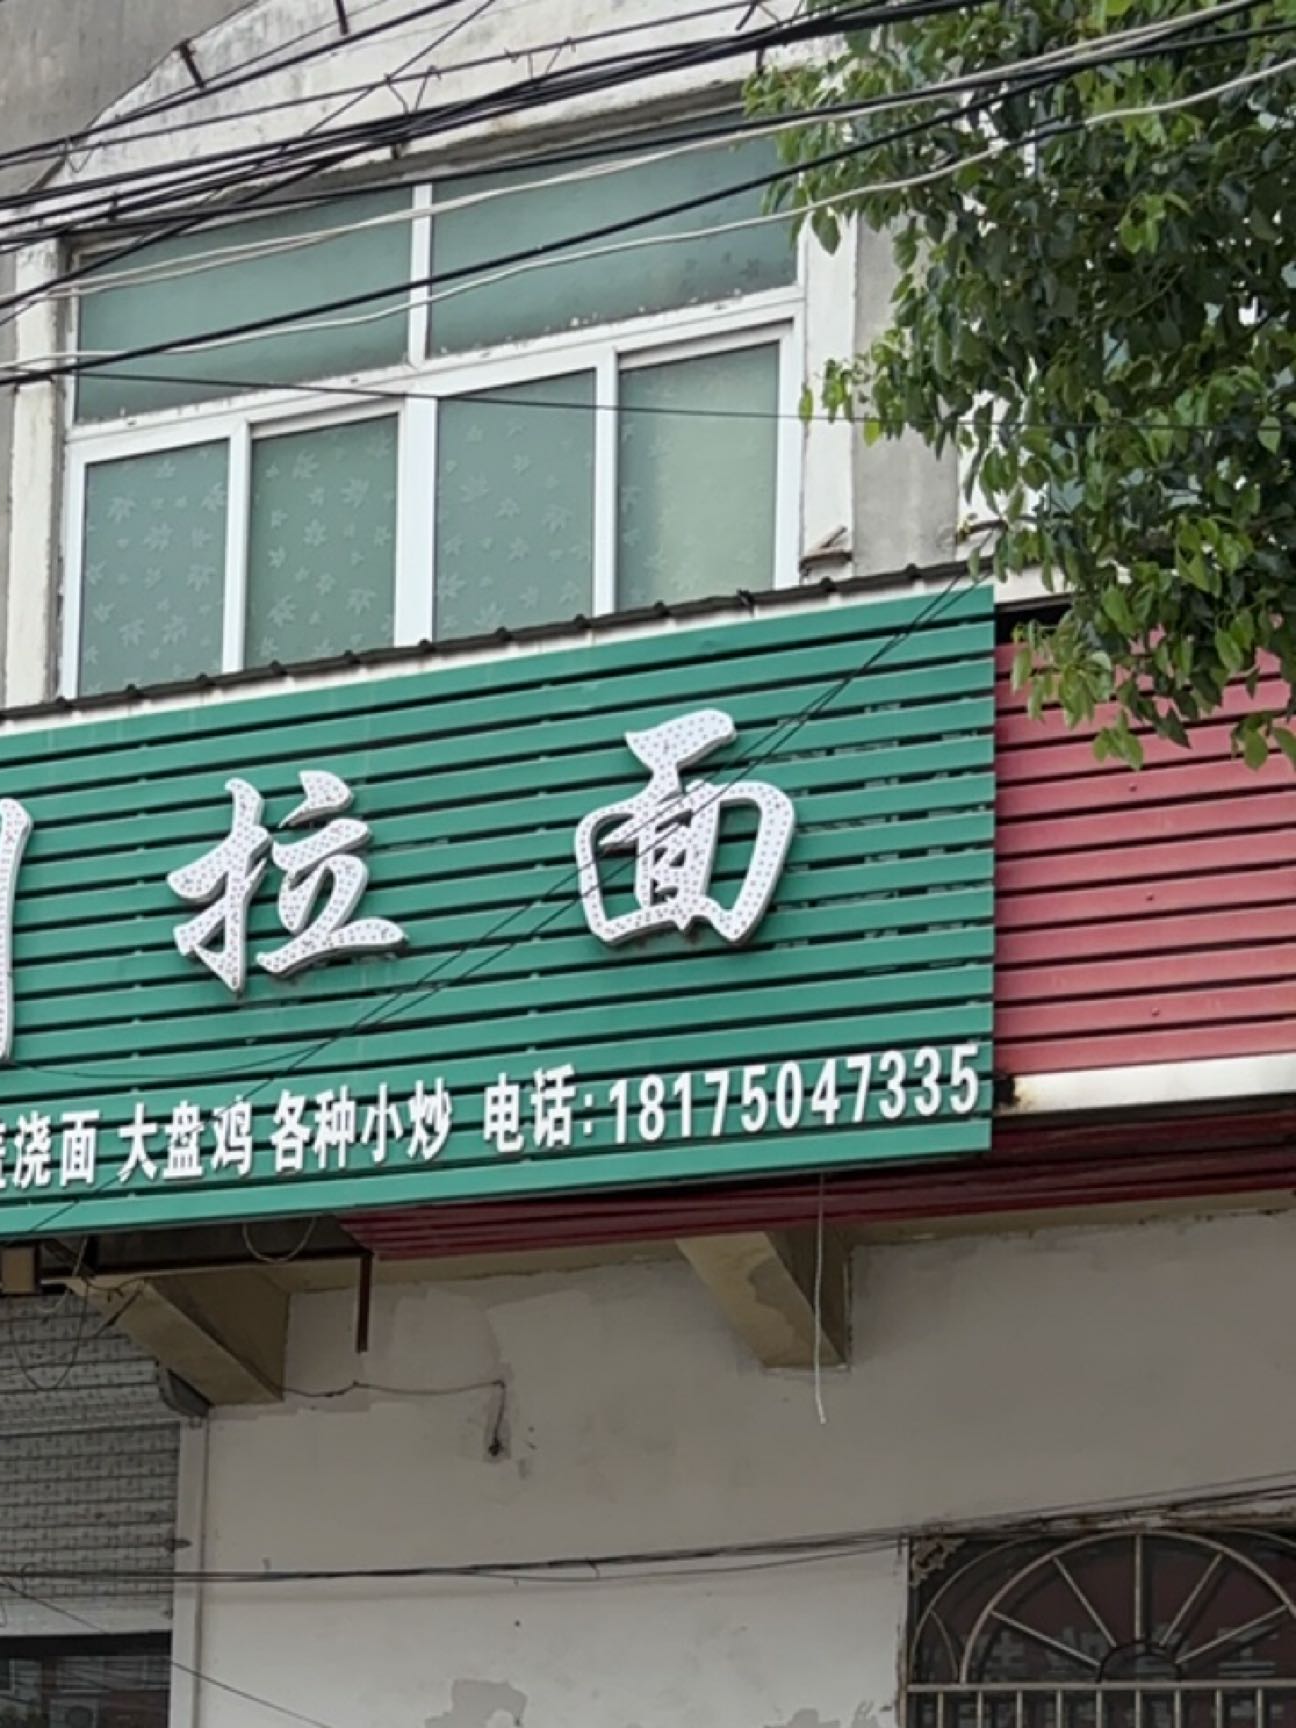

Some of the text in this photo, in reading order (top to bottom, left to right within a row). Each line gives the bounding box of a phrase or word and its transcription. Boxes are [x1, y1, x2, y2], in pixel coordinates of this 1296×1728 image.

[117, 1094, 253, 1183] 大盘鸡
[270, 1076, 453, 1174] 各种小炒
